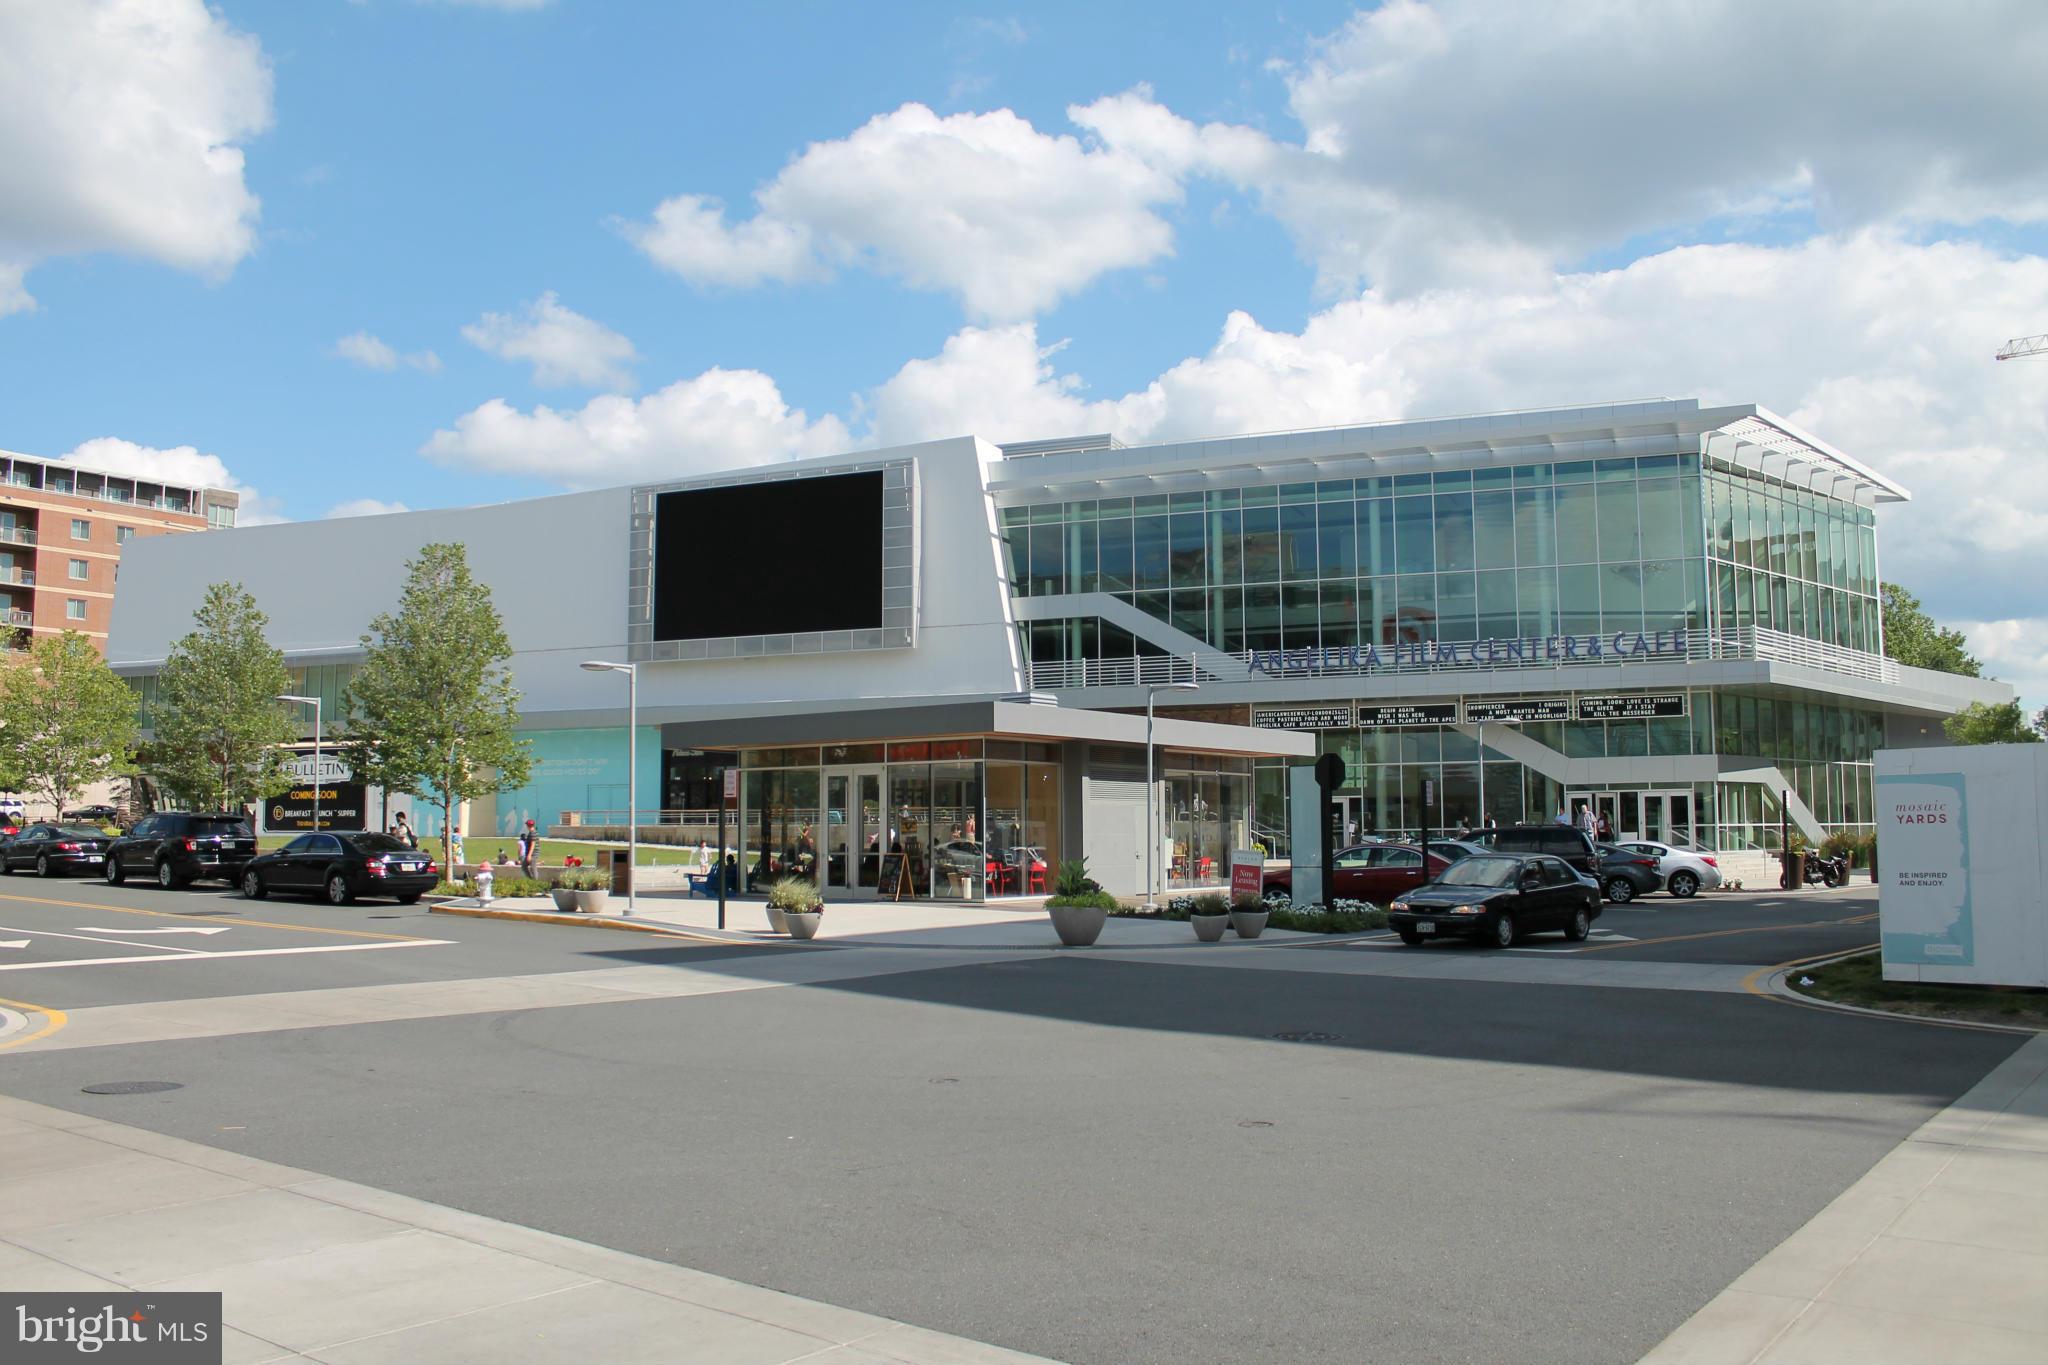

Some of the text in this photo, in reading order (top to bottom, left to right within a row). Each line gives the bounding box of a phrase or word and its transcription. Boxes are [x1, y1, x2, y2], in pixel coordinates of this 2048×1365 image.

[1248, 643, 1382, 672] ANGELIKA
[1395, 642, 1459, 666] FILM
[1471, 635, 1577, 661] CENTER
[1587, 635, 1602, 656] &
[290, 790, 317, 800] COMING
[1895, 799, 1947, 812] mosaic
[284, 809, 312, 817] BREAKFAST
[337, 809, 356, 817] SUPPER
[1896, 813, 1947, 824] YARDS
